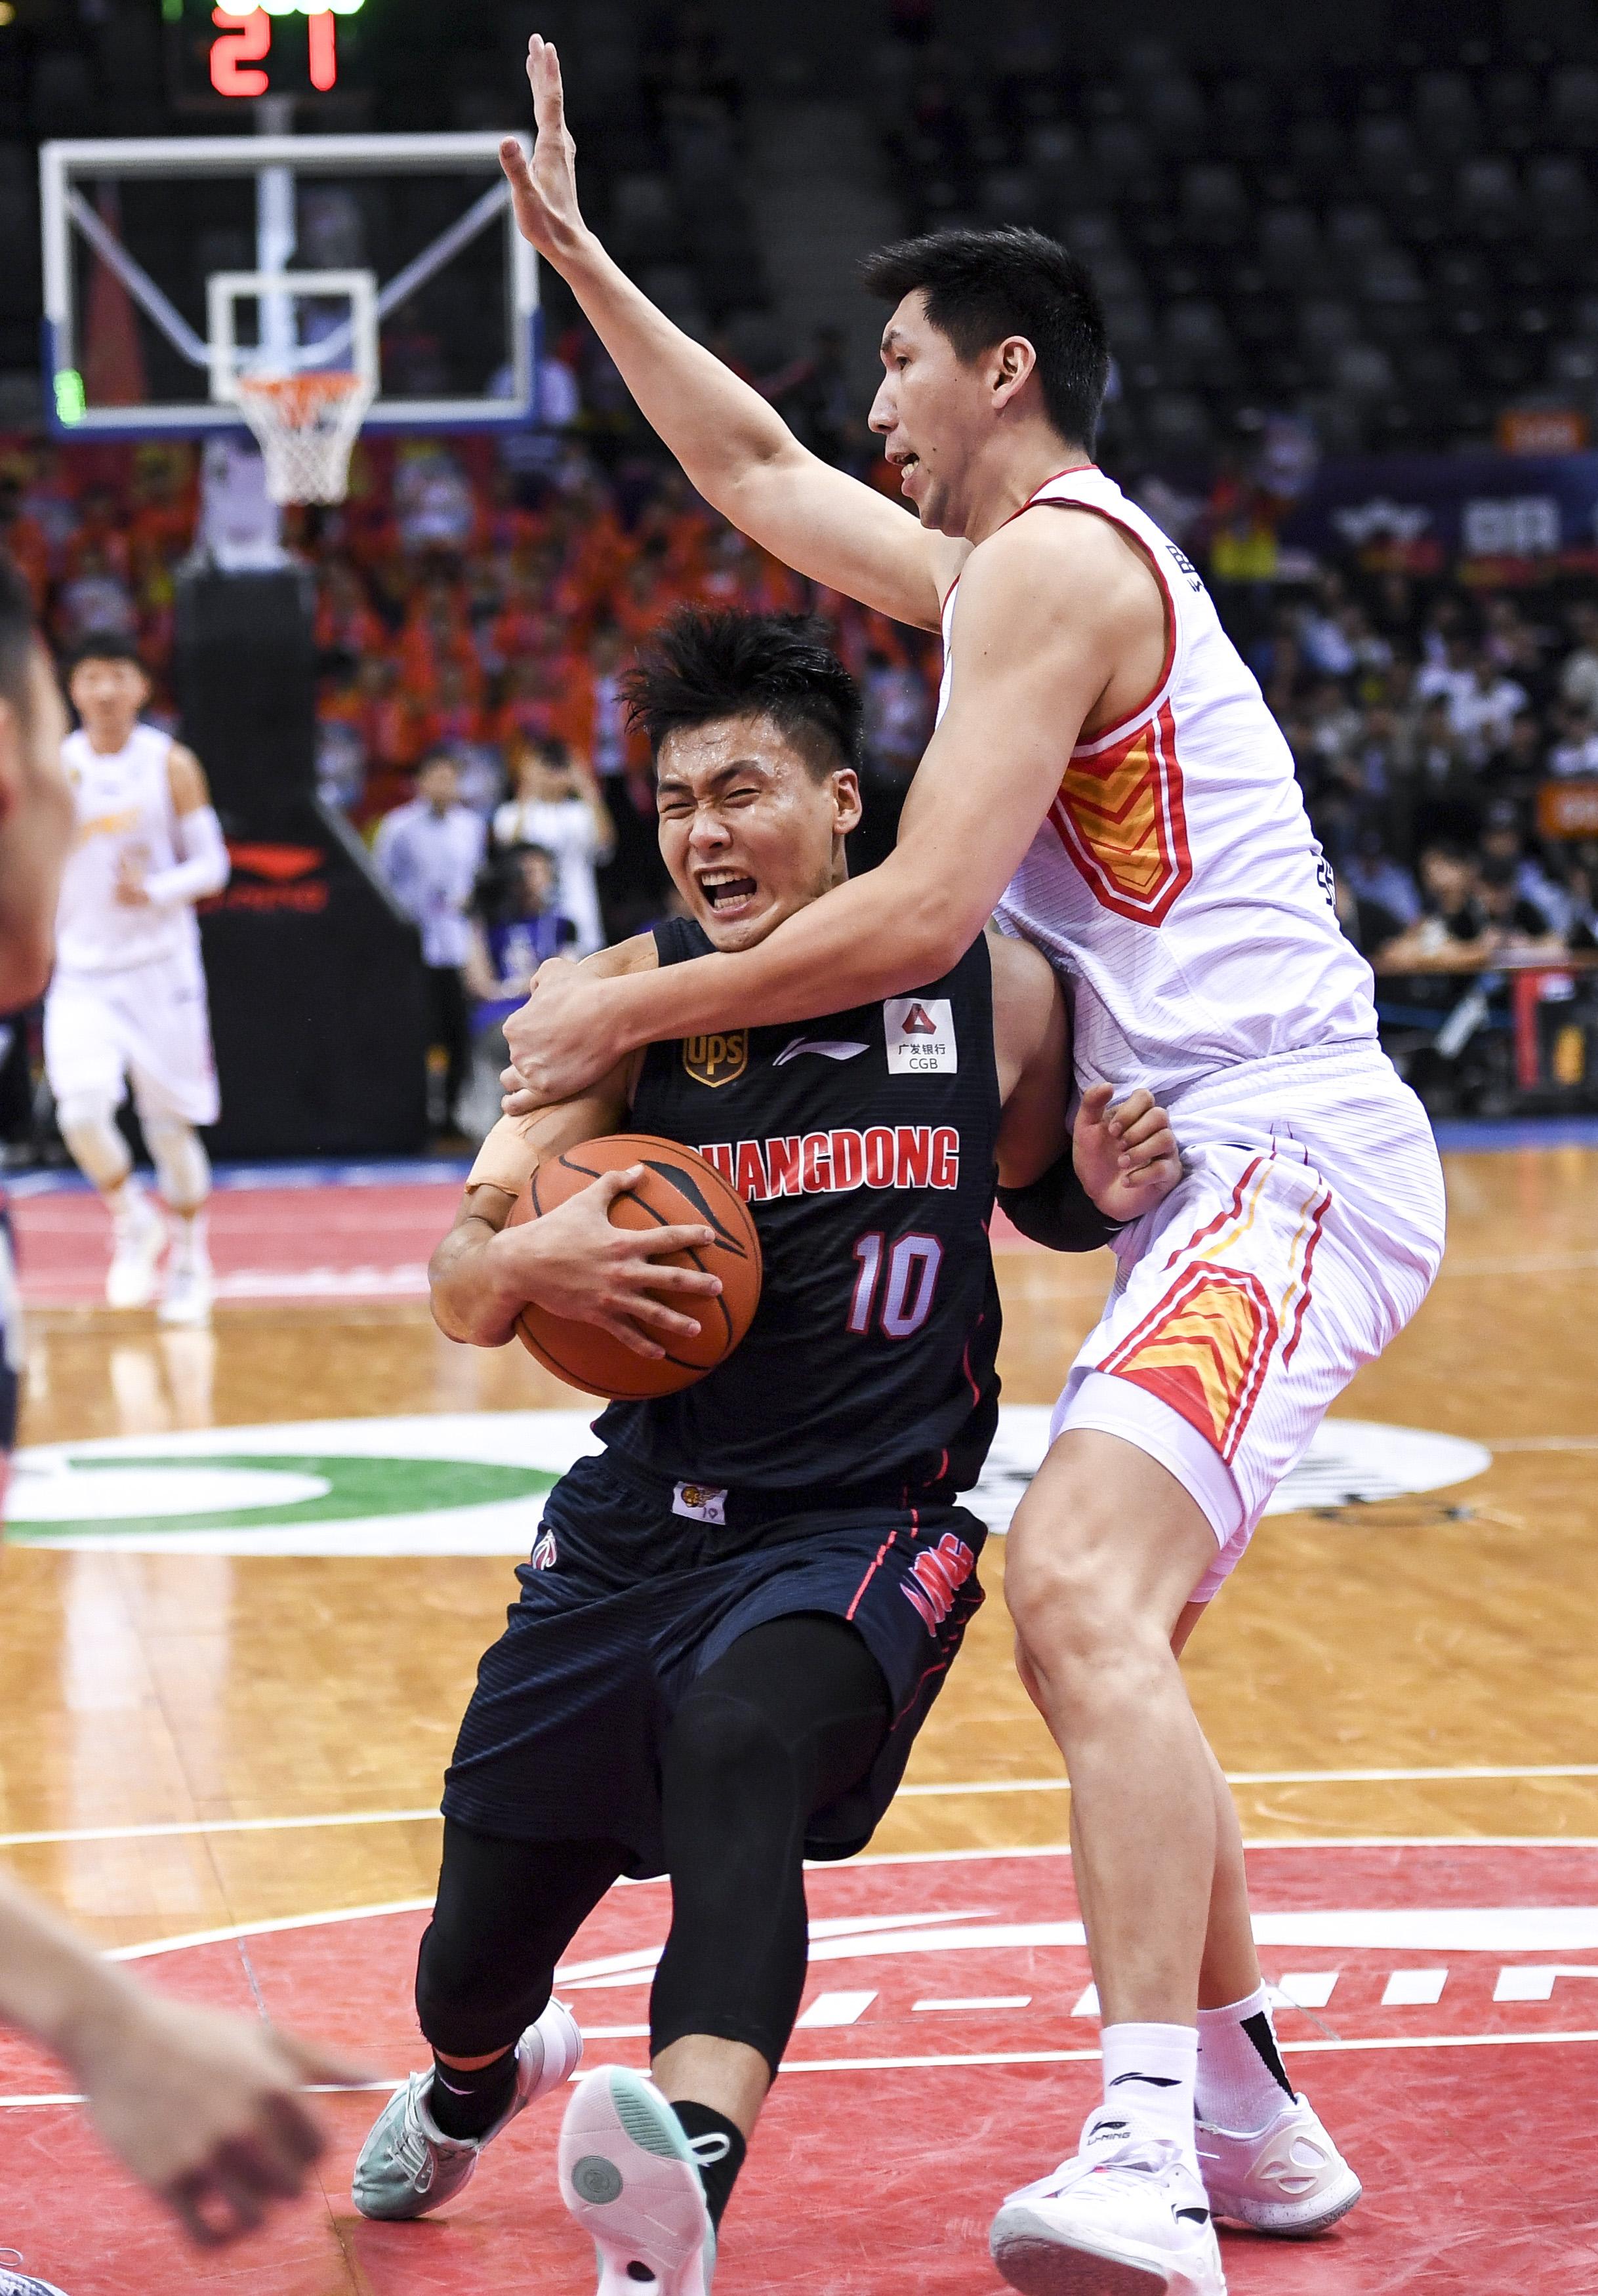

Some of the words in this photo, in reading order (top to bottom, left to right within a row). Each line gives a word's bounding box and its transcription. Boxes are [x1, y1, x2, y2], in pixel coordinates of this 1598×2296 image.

[209, 3, 337, 96] 21
[688, 1035, 743, 1075] ups
[898, 1044, 946, 1055] 广发银行
[909, 1058, 938, 1069] CGB
[686, 1126, 960, 1203] ANGDONG
[846, 1231, 945, 1340] 10
